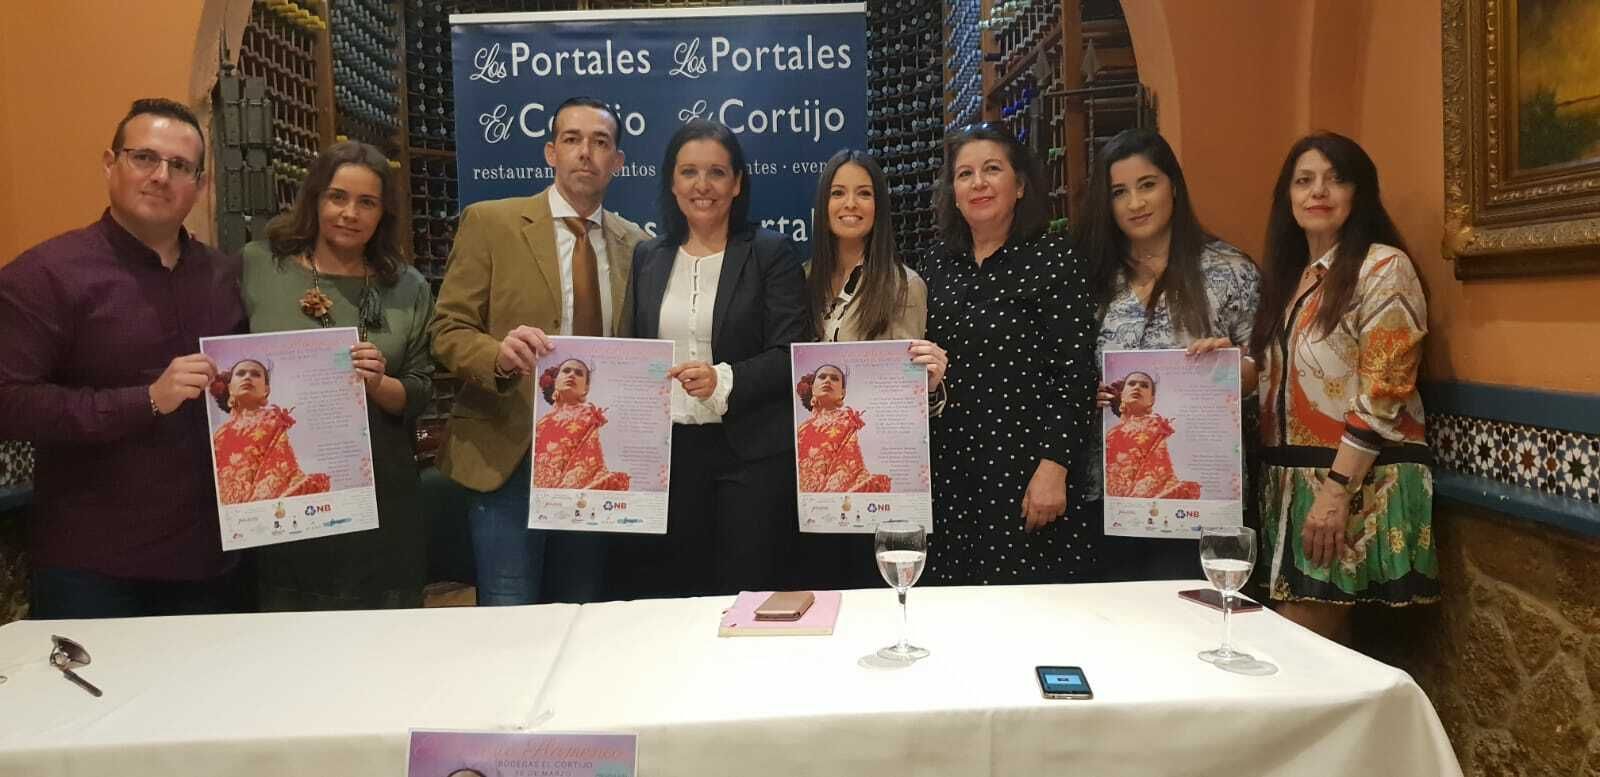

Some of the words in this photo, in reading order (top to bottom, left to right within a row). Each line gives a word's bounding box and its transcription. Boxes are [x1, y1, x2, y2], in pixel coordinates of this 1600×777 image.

[470, 43, 507, 83] Los
[511, 40, 651, 77] Portales
[669, 37, 707, 79] Los
[711, 34, 851, 72] Portales
[479, 104, 514, 144] El
[678, 100, 714, 125] E
[719, 98, 845, 142] Cortijo
[473, 165, 554, 180] restauran
[613, 161, 656, 177] ntos
[792, 161, 827, 174] even
